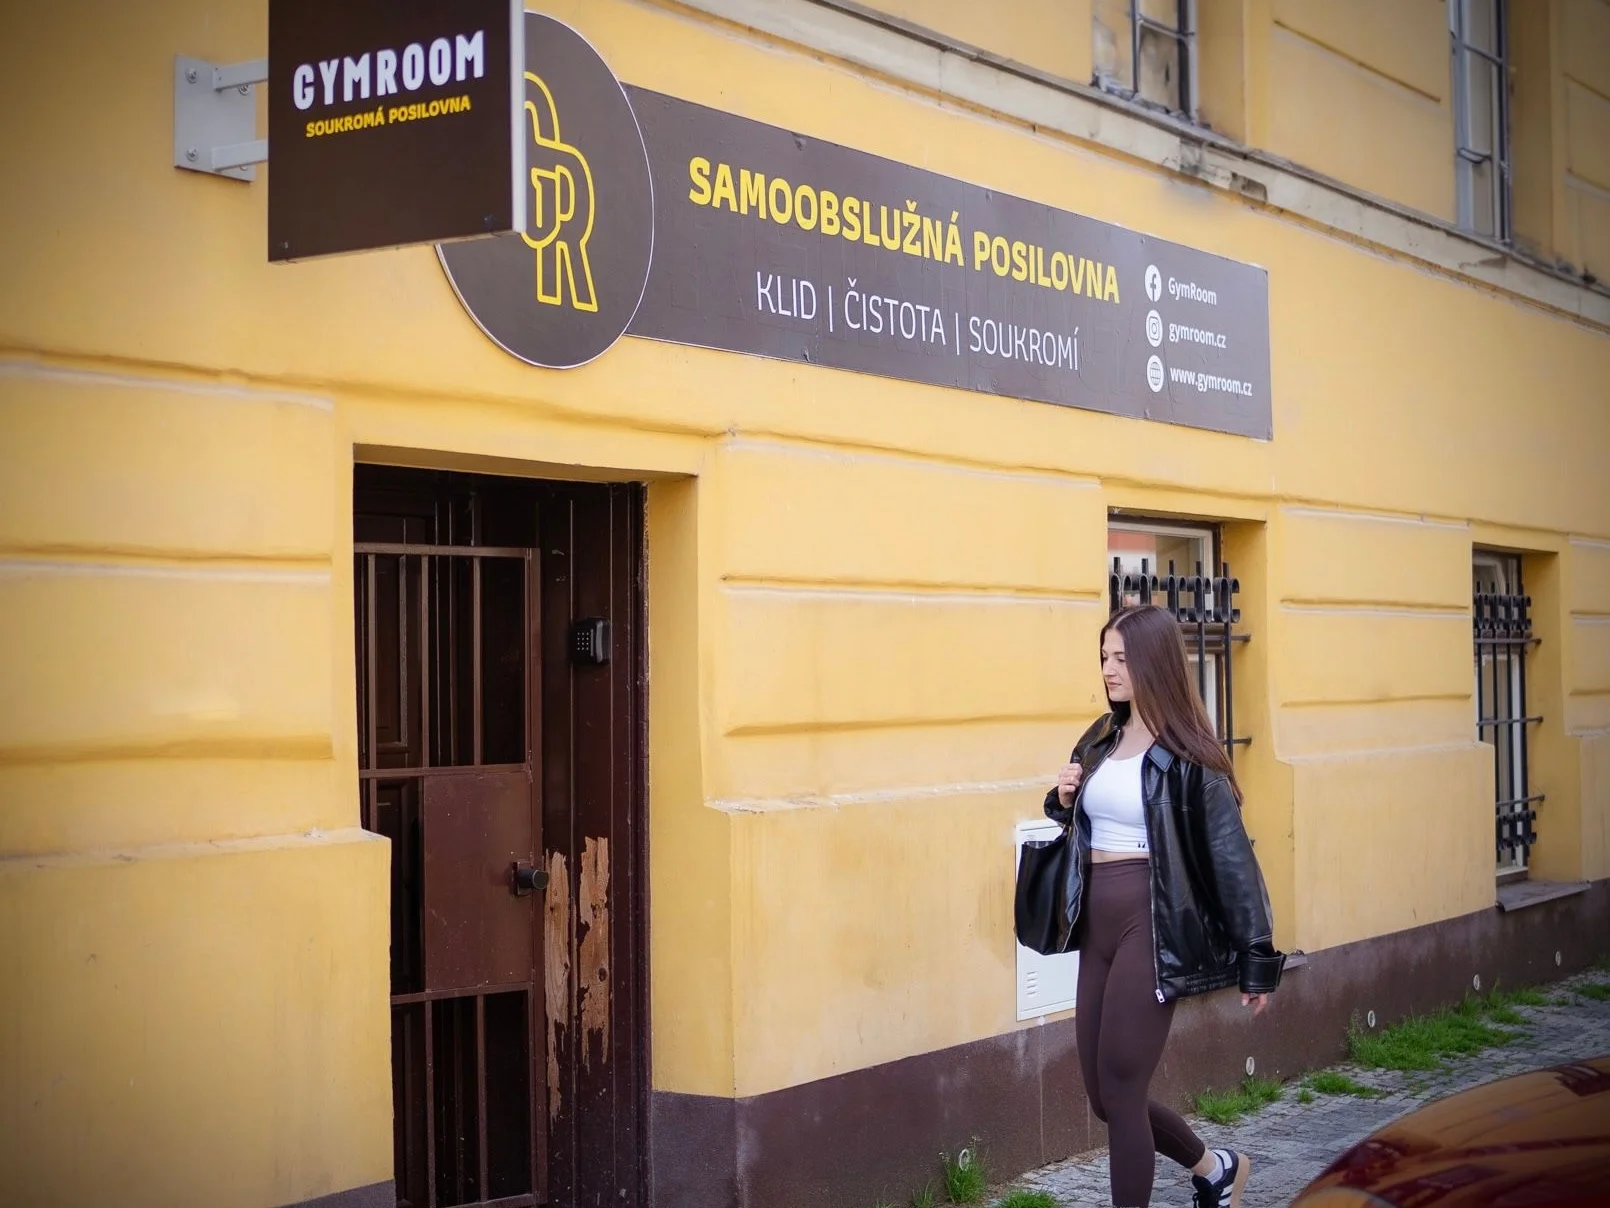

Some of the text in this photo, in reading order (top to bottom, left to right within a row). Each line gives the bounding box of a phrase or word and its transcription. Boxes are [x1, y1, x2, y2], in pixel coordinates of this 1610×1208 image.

[293, 30, 484, 109] GYMROOM
[305, 95, 472, 138] SOUKROMÁ POSILOVNA
[688, 156, 1120, 304] SAMOOBSLUŽNÁ POSILOVNA
[1168, 277, 1217, 305] GymRoom
[756, 271, 817, 320] KLID
[844, 277, 946, 345] ČISTOTA
[969, 316, 1080, 371] SOUKROMÍ
[1169, 323, 1227, 348] gymroom.cz
[1170, 367, 1253, 396] www.gymroom.cz
